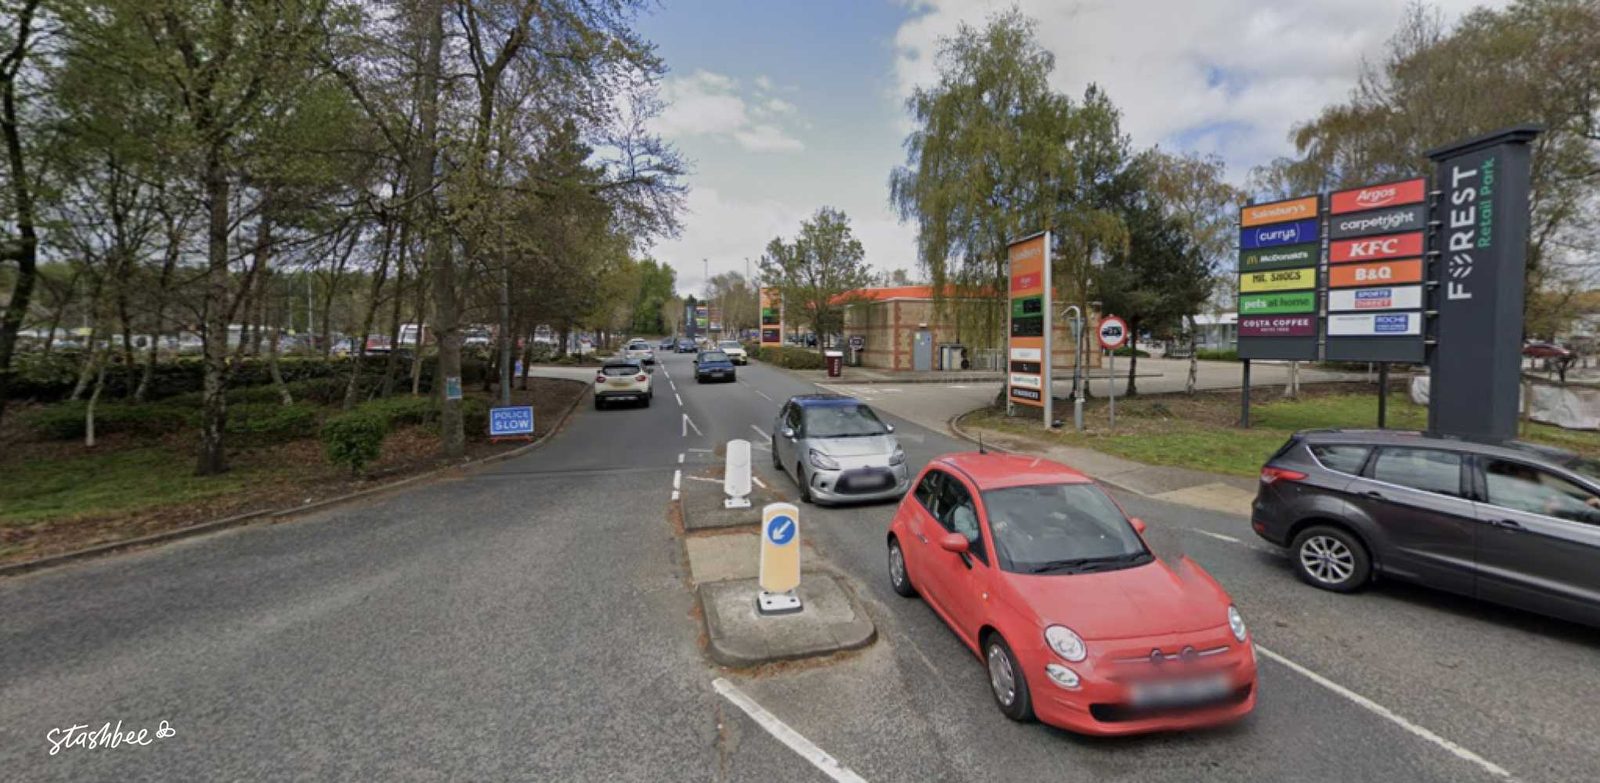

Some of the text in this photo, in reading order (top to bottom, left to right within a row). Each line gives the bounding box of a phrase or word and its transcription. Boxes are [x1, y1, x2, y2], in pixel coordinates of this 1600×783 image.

[1357, 188, 1397, 202] Argos
[1478, 157, 1495, 248] Retail Park
[1340, 212, 1415, 231] carpetright
[1350, 238, 1398, 257] KFC
[1260, 251, 1308, 262] McDonald's
[1355, 266, 1392, 281] B&Q
[1245, 297, 1310, 311] pets at home
[1243, 318, 1309, 328] COSTA COFFEE
[494, 410, 529, 420] POLICE
[494, 419, 529, 430] SLOW
